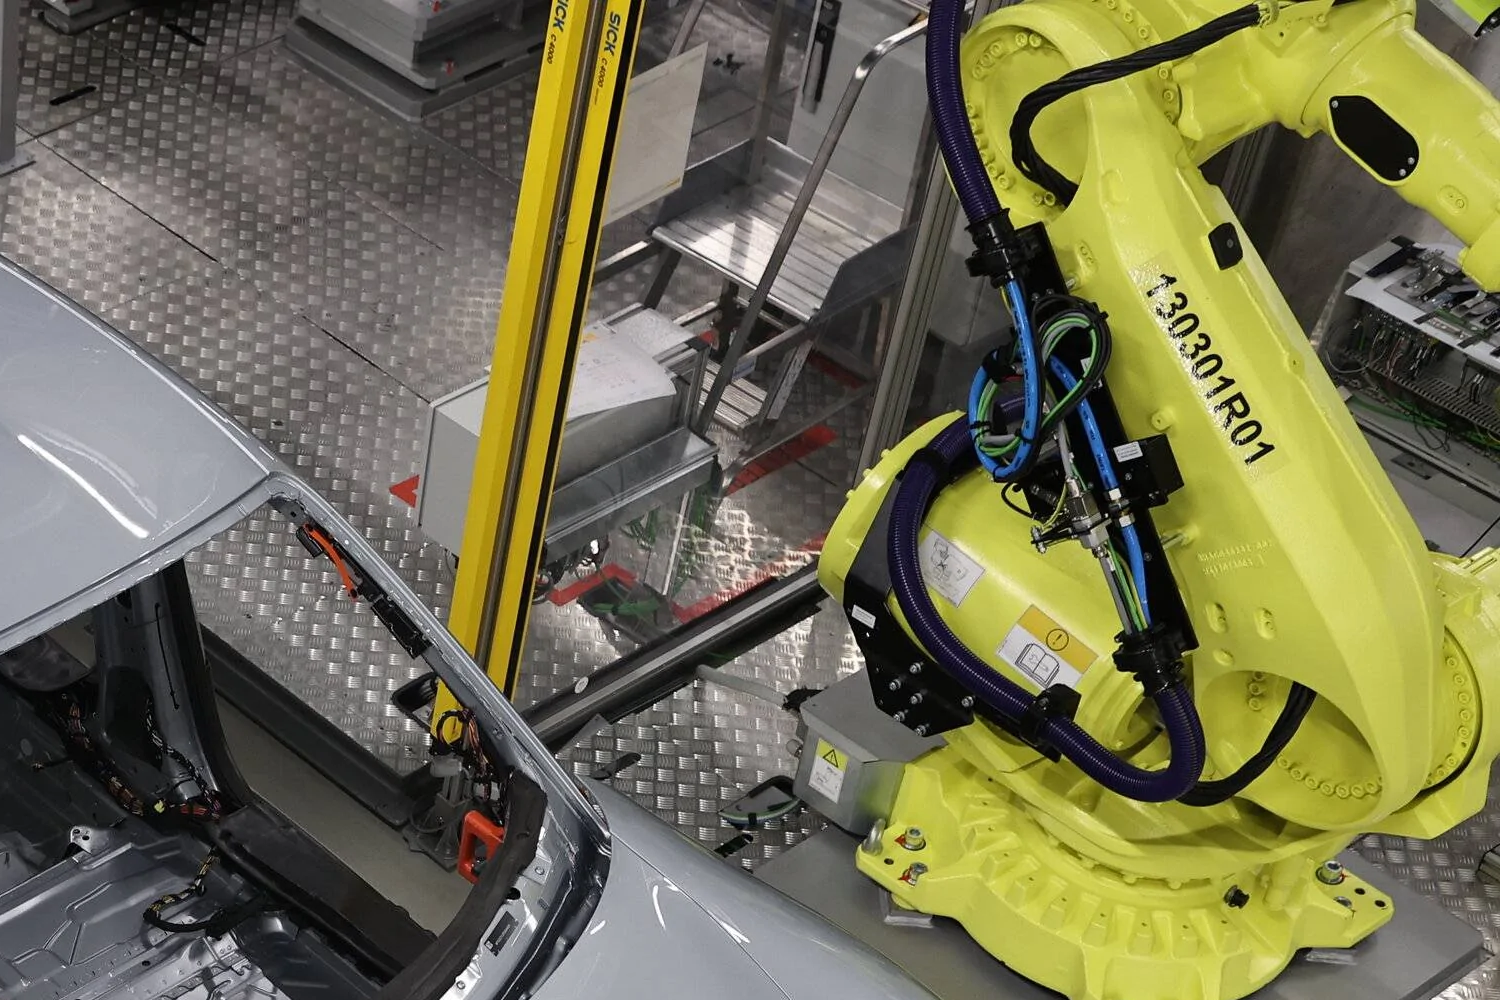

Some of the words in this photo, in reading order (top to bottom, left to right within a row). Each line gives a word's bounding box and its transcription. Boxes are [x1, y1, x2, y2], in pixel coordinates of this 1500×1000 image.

[553, 0, 569, 32] ICK
[604, 11, 621, 56] SICK
[1146, 273, 1276, 466] 130301R01
